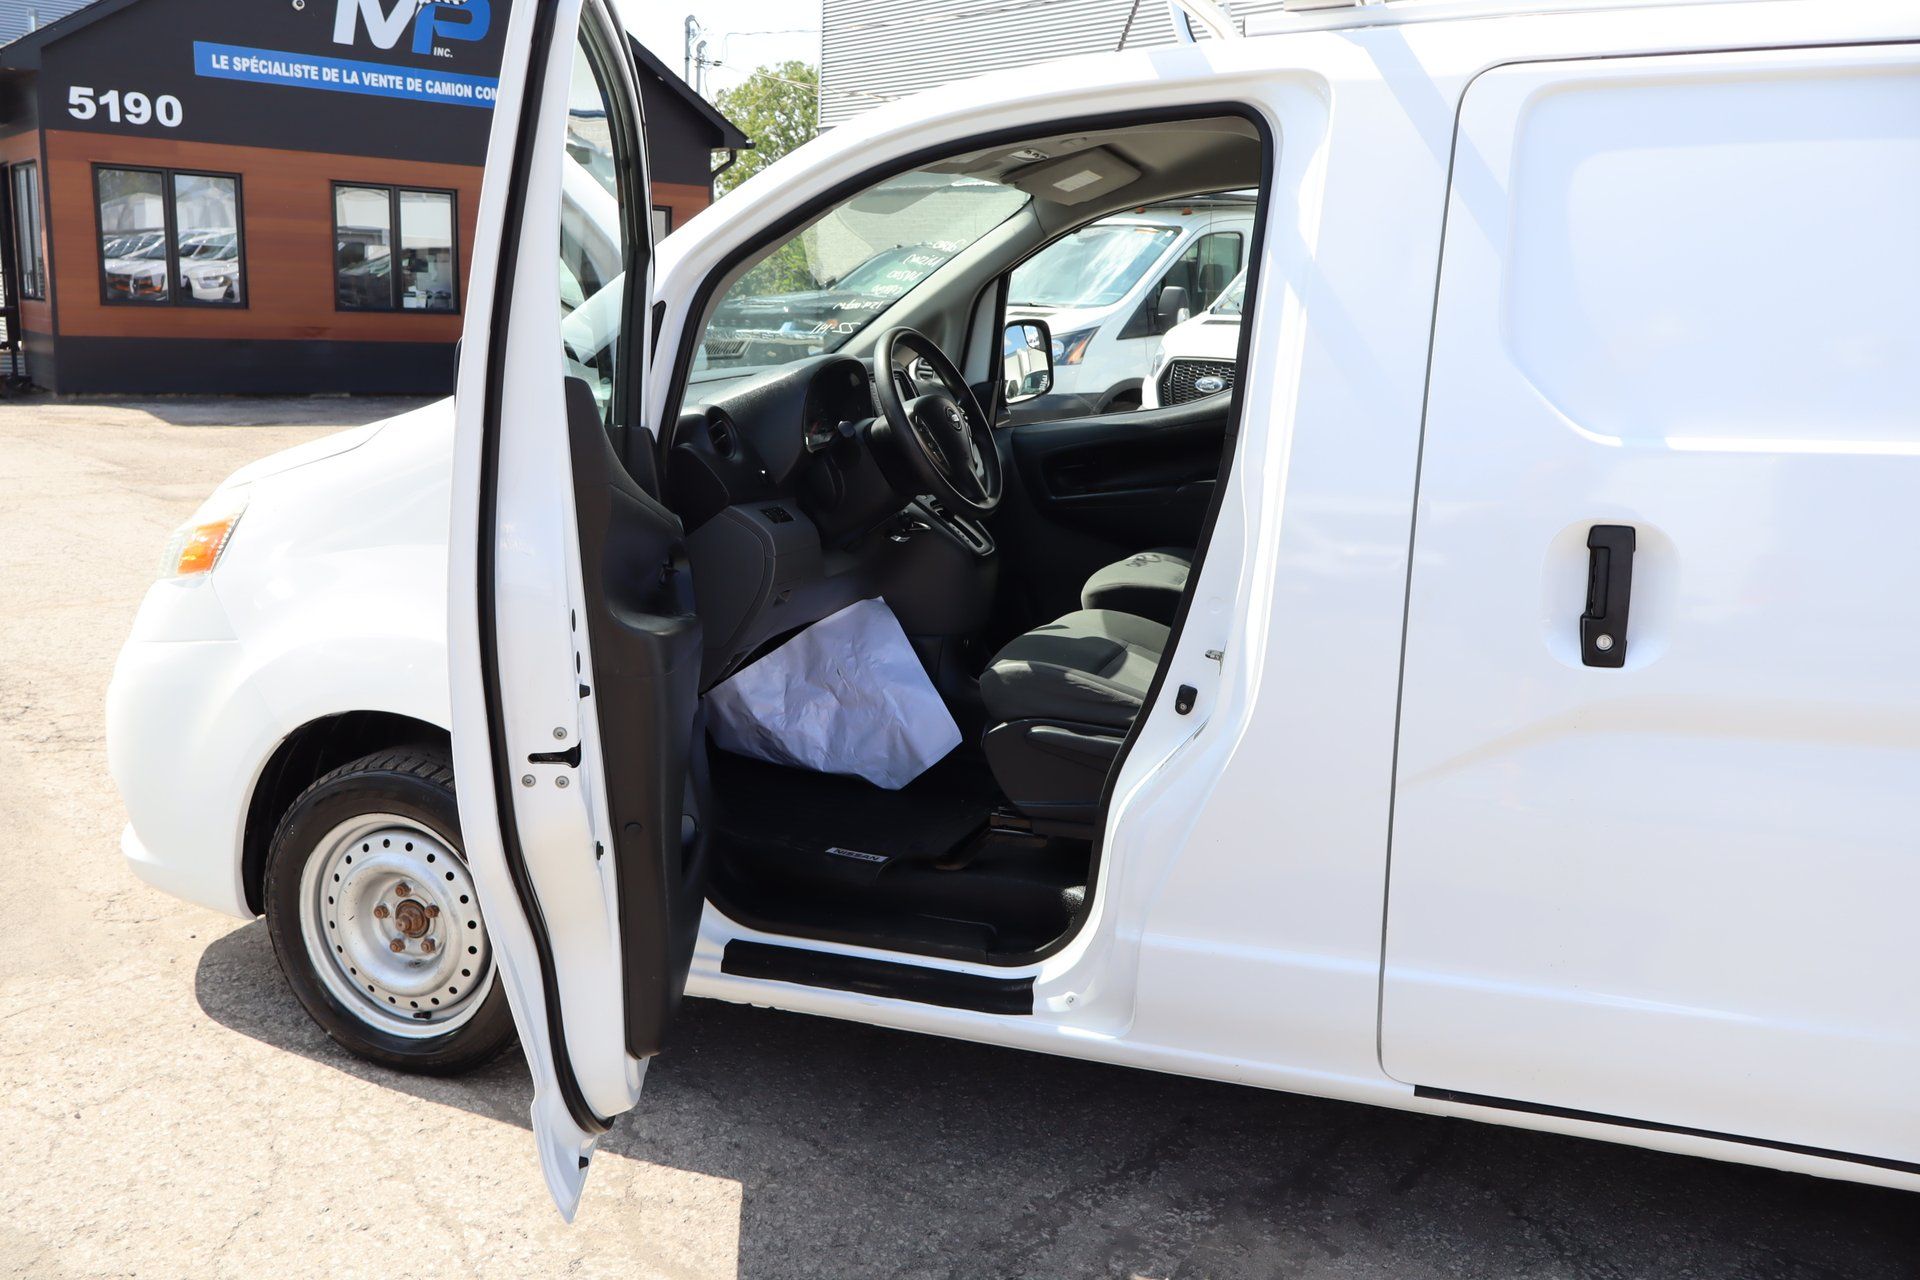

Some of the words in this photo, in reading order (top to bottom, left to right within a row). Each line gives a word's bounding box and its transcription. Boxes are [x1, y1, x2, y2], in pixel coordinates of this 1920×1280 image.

[433, 46, 454, 58] INC.
[211, 53, 230, 70] LE
[232, 56, 320, 81] SPÉCIALISTE
[322, 66, 340, 82] DE
[342, 69, 360, 85] LA
[362, 71, 404, 90] VENTE
[406, 77, 423, 92] DE
[425, 79, 472, 98] CAMION
[68, 85, 183, 128] 5190
[833, 847, 880, 861] NISSAN
